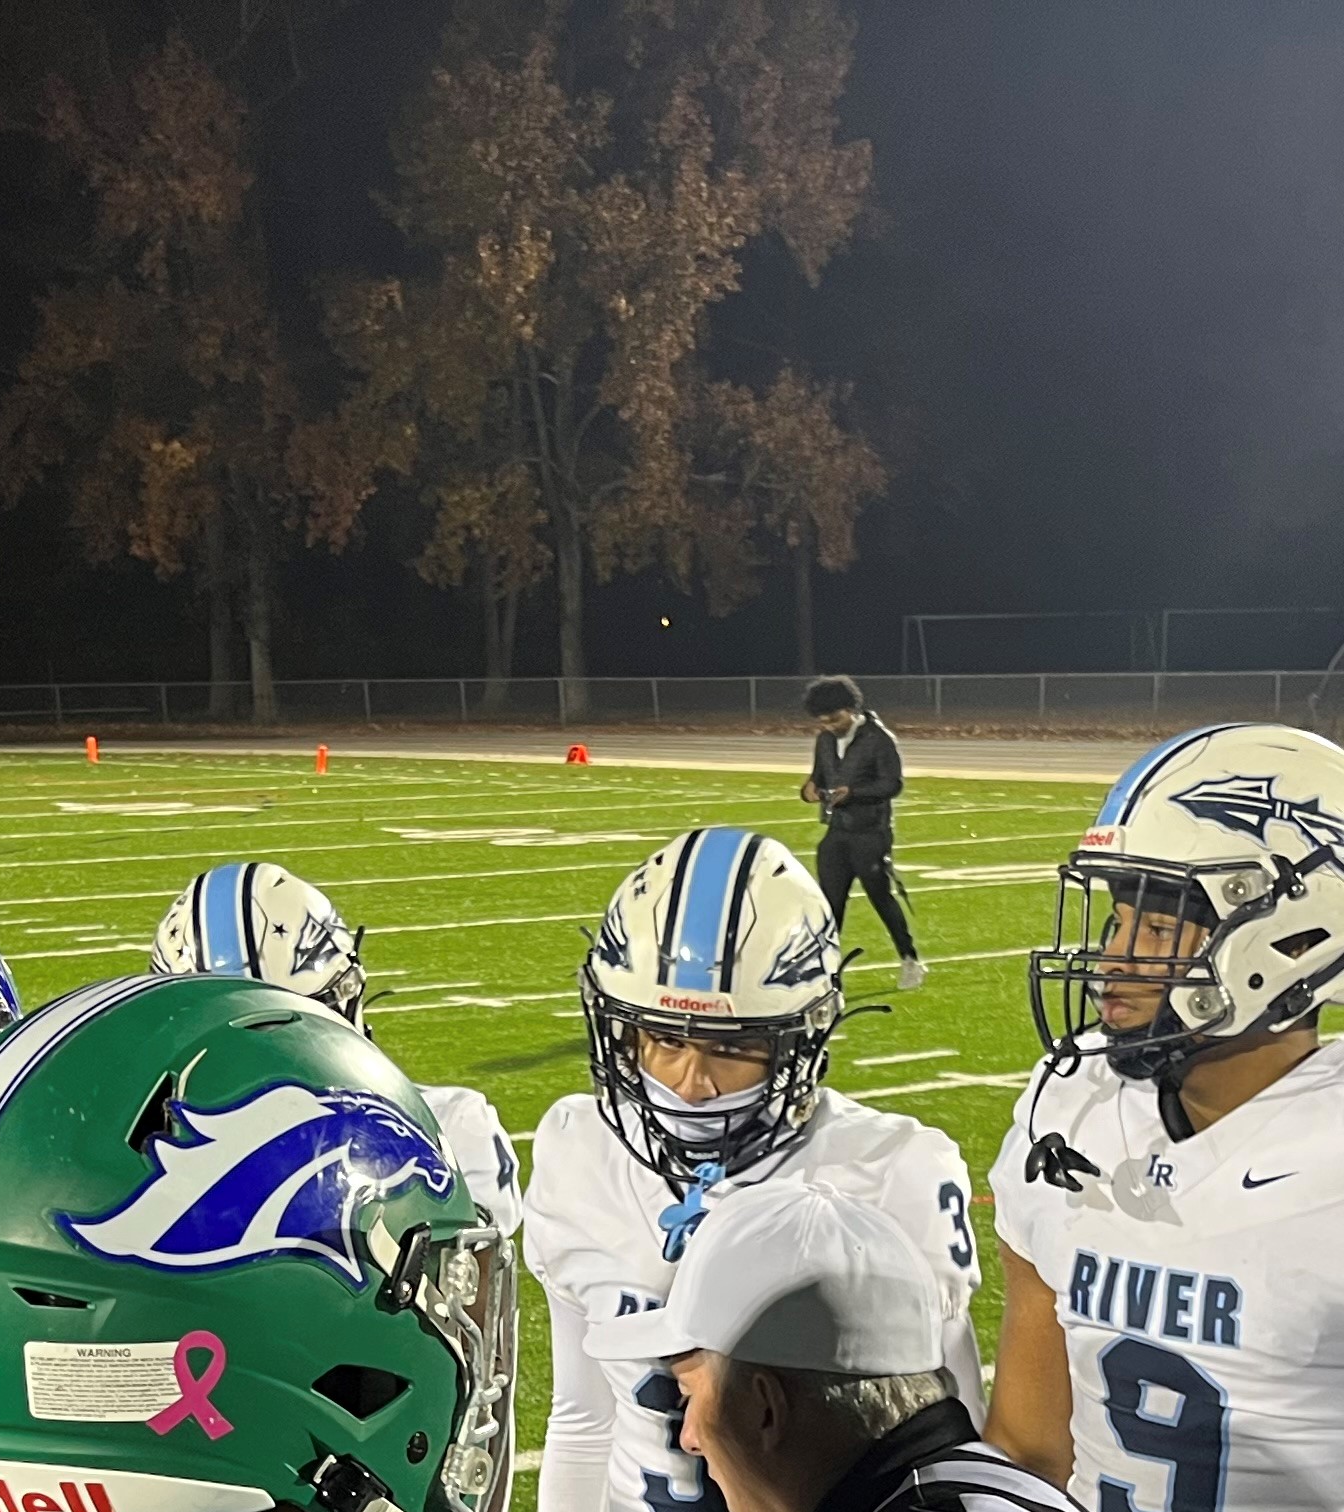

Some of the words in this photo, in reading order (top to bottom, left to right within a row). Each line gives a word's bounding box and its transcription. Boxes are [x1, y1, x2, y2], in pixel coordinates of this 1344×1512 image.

[937, 1180, 973, 1270] 3
[1067, 1247, 1244, 1350] RIVER
[76, 1348, 132, 1358] WARNING
